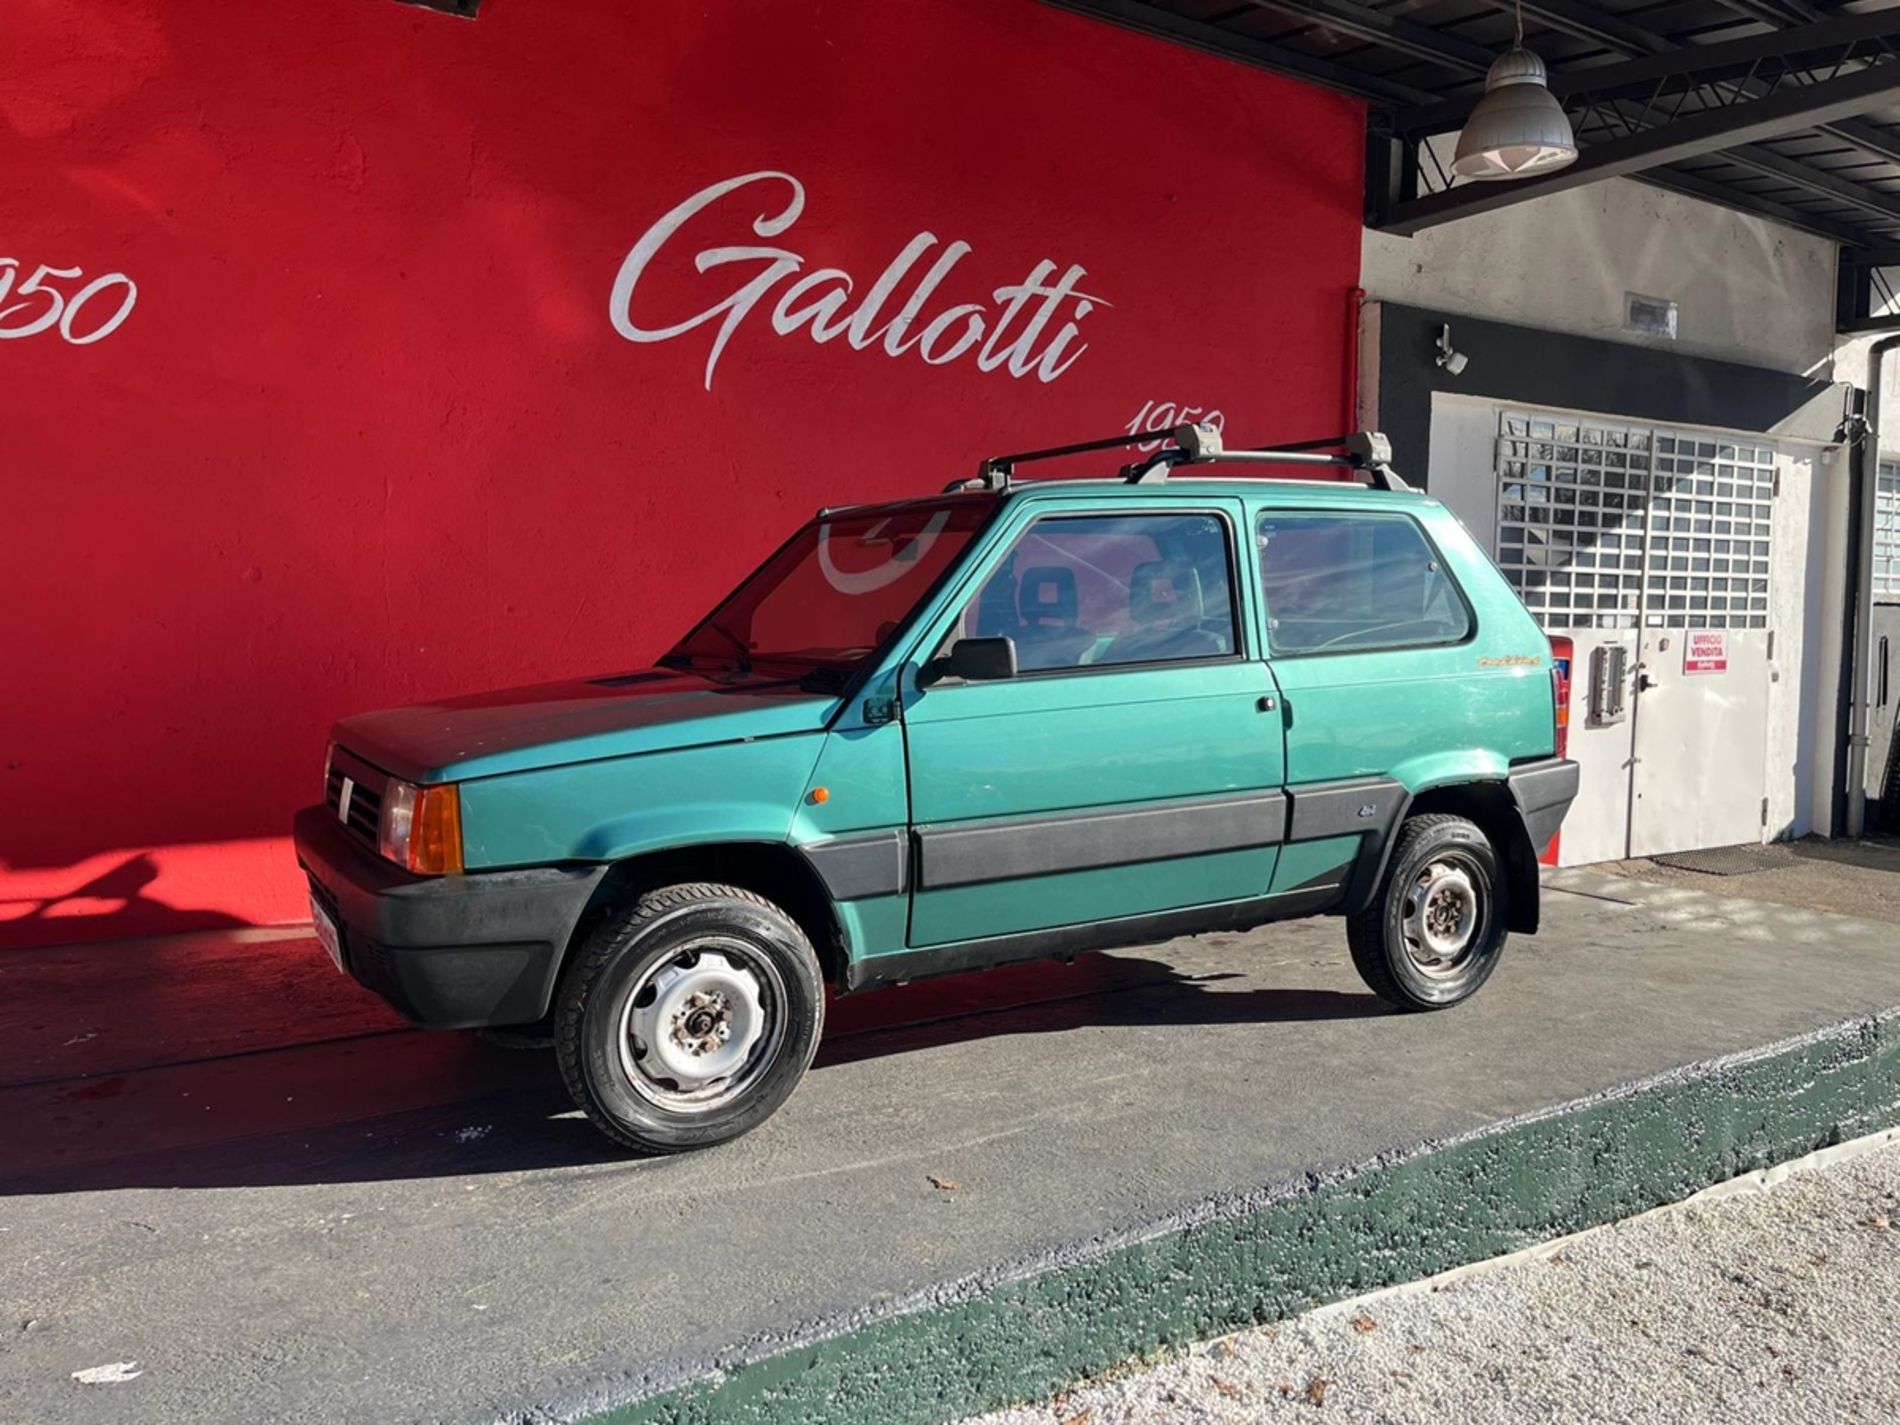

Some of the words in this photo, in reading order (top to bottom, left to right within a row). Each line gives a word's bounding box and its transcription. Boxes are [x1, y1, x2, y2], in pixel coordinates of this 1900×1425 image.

[0, 257, 138, 345] 50
[609, 170, 1114, 391] Gallotti
[1691, 647, 1723, 657] VENDITA
